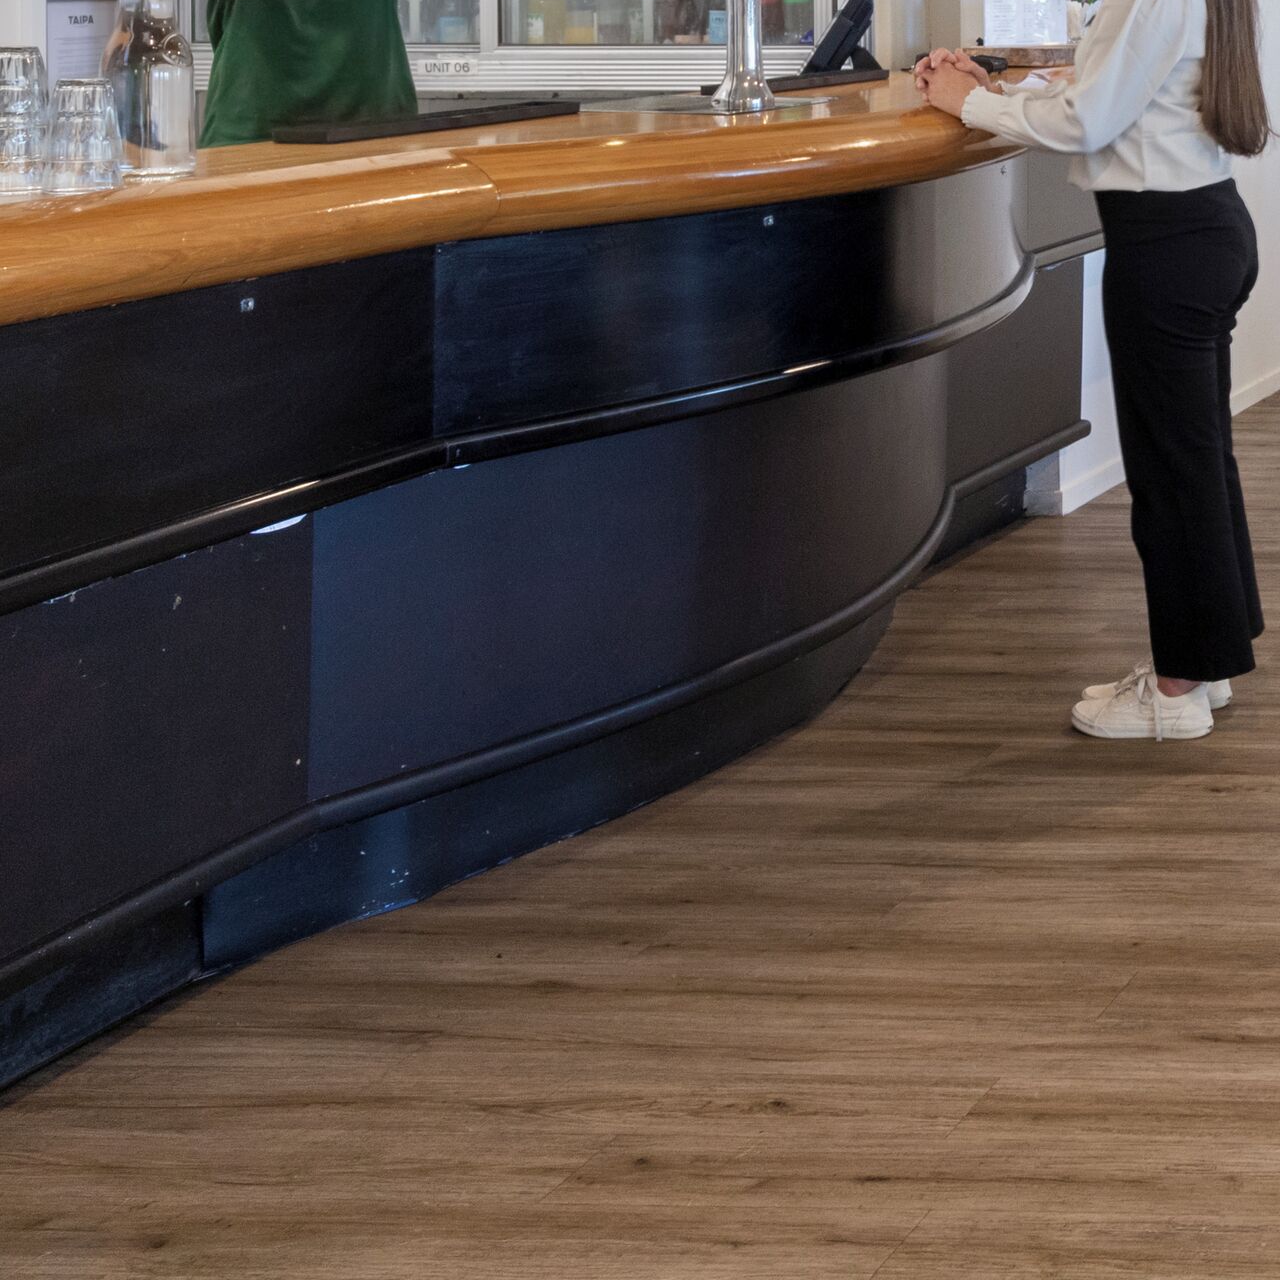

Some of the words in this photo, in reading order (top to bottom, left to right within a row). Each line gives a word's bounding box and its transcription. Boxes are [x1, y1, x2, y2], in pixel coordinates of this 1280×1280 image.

[68, 15, 94, 24] TAIPA
[425, 62, 451, 73] UNIT
[454, 62, 470, 73] 06
